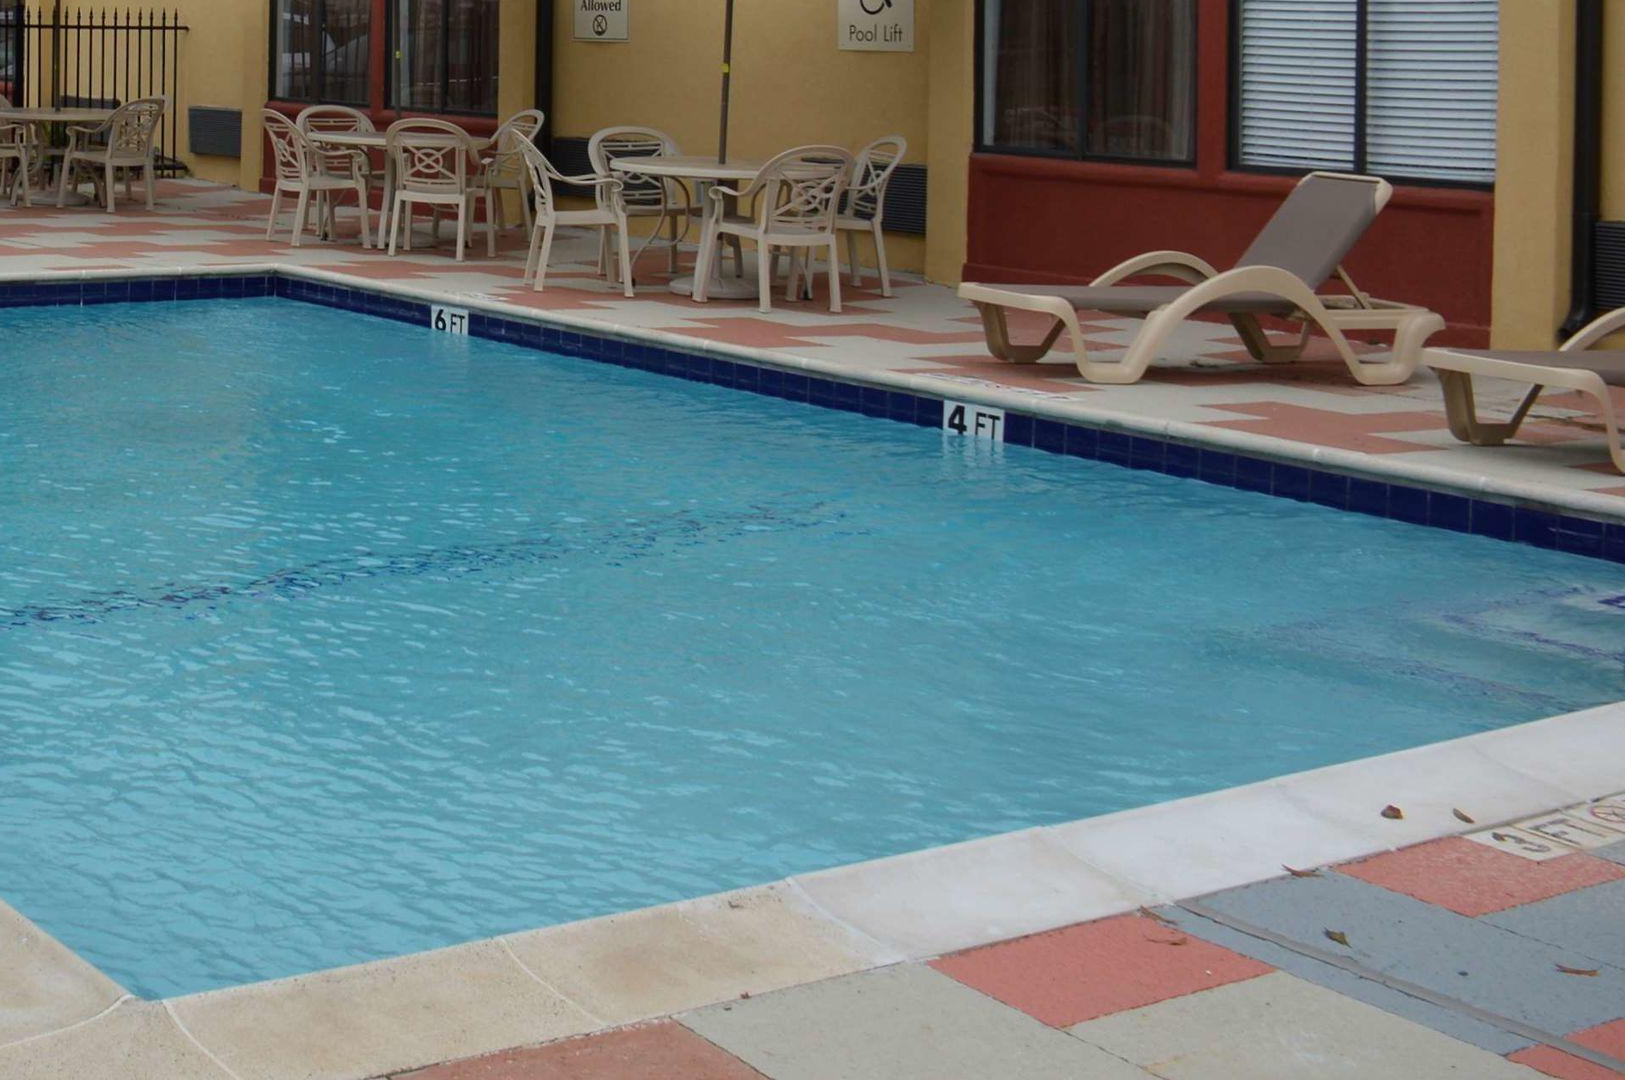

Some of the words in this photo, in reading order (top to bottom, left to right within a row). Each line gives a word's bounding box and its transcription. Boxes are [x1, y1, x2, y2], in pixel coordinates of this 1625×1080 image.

[849, 24, 878, 42] Pool
[883, 23, 903, 42] Lift
[435, 309, 447, 331] 6
[450, 313, 466, 334] FT
[948, 405, 968, 435] 4
[975, 412, 1001, 440] FT
[1492, 831, 1551, 853] 3
[1528, 818, 1608, 847] FT
